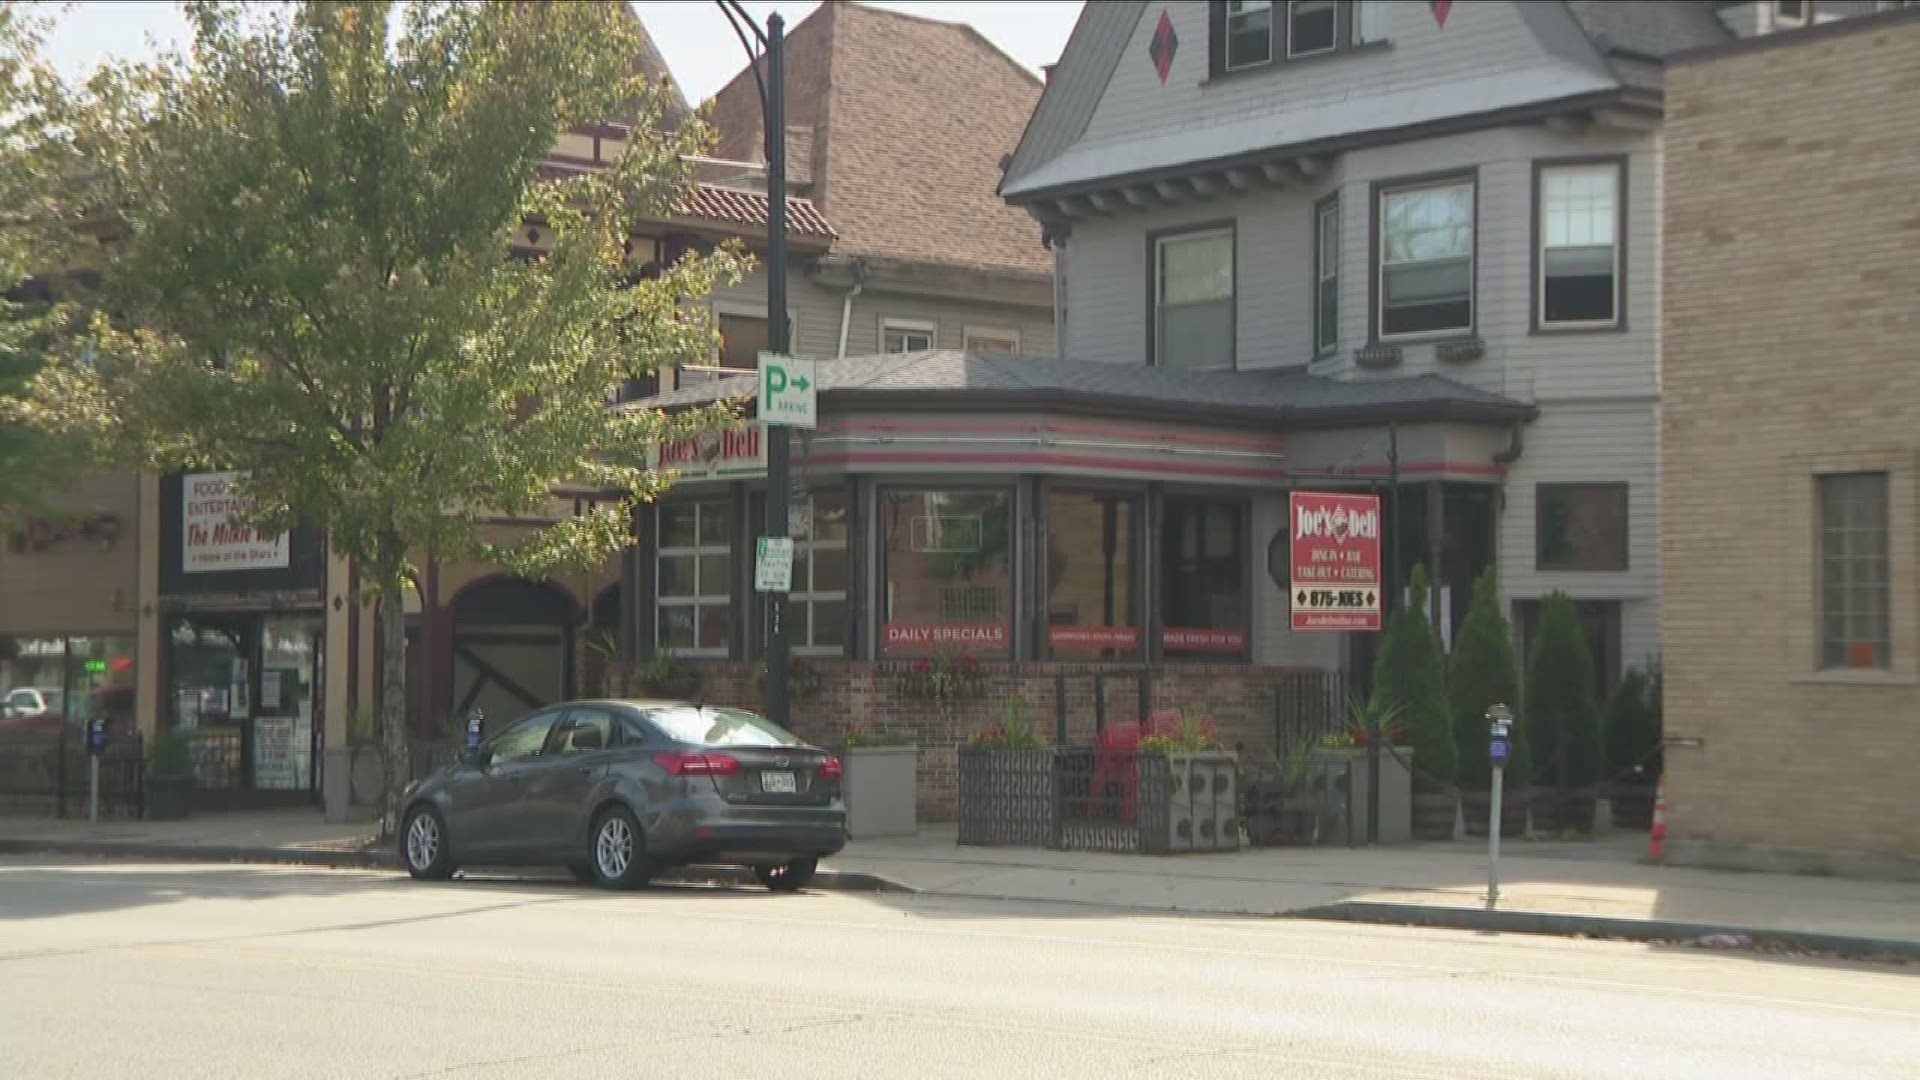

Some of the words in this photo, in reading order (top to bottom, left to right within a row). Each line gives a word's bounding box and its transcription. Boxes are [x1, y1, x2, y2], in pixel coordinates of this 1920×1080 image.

[194, 480, 226, 496] FOOD
[1295, 504, 1333, 541] Joe's
[1348, 508, 1377, 540] Deli
[188, 522, 209, 548] The
[213, 522, 252, 546] Milkie
[889, 628, 930, 640] DAILY
[934, 628, 1003, 640] SPECIALS
